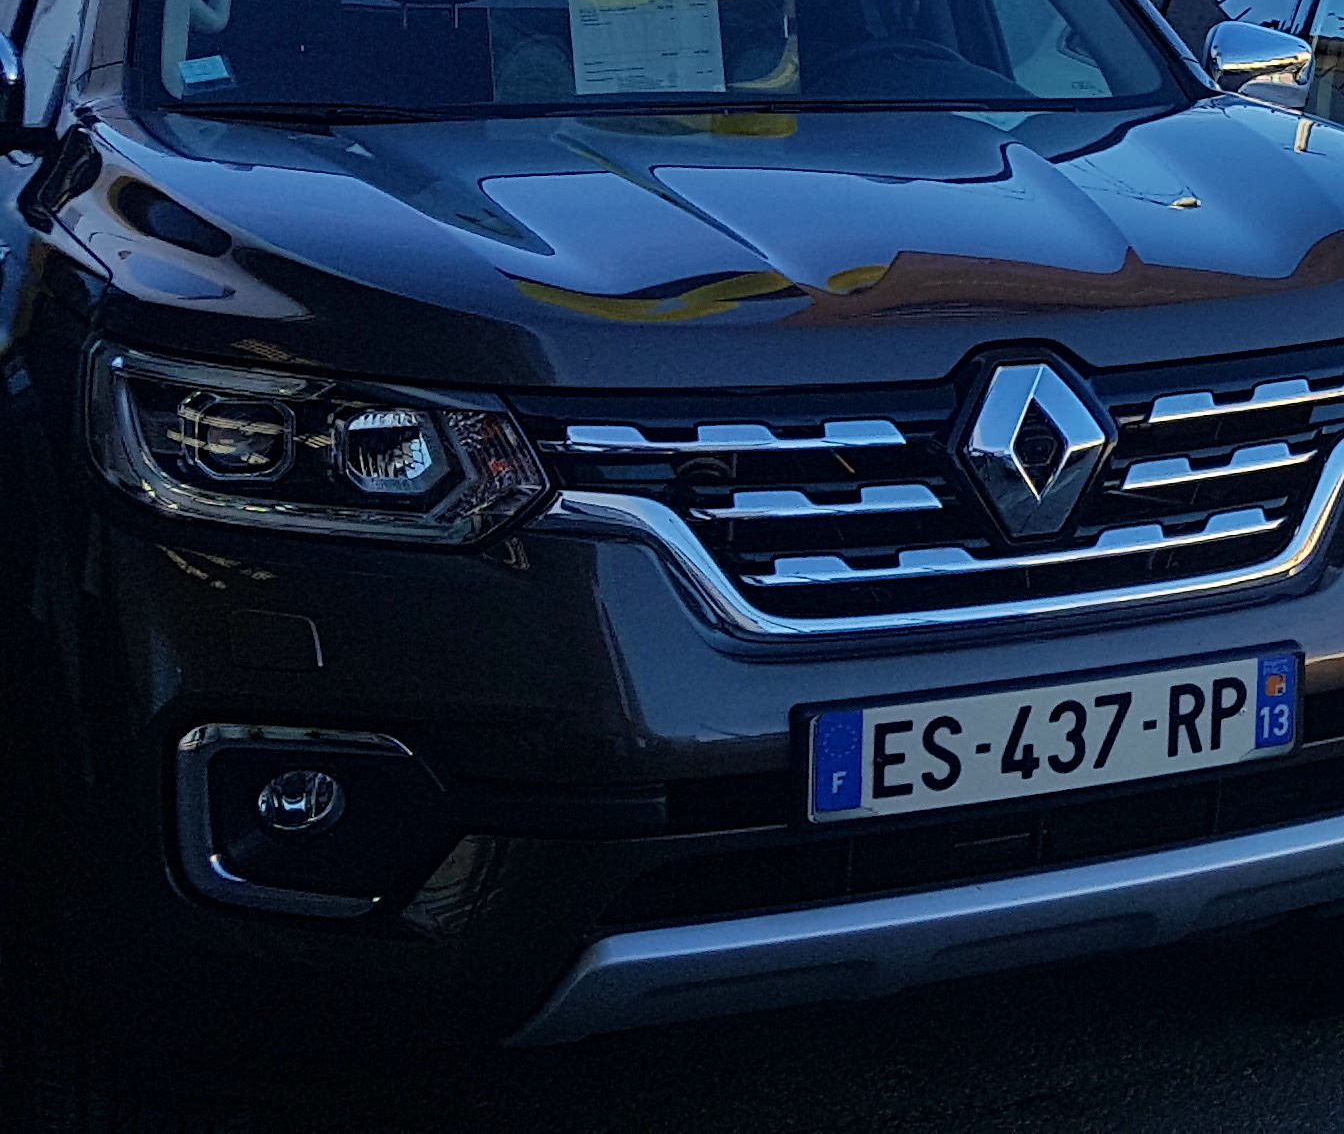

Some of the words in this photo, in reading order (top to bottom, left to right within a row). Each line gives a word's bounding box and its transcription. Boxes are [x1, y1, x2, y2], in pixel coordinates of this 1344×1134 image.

[831, 770, 848, 795] F
[872, 675, 1249, 800] ES-437-RP
[1259, 704, 1291, 739] 13
